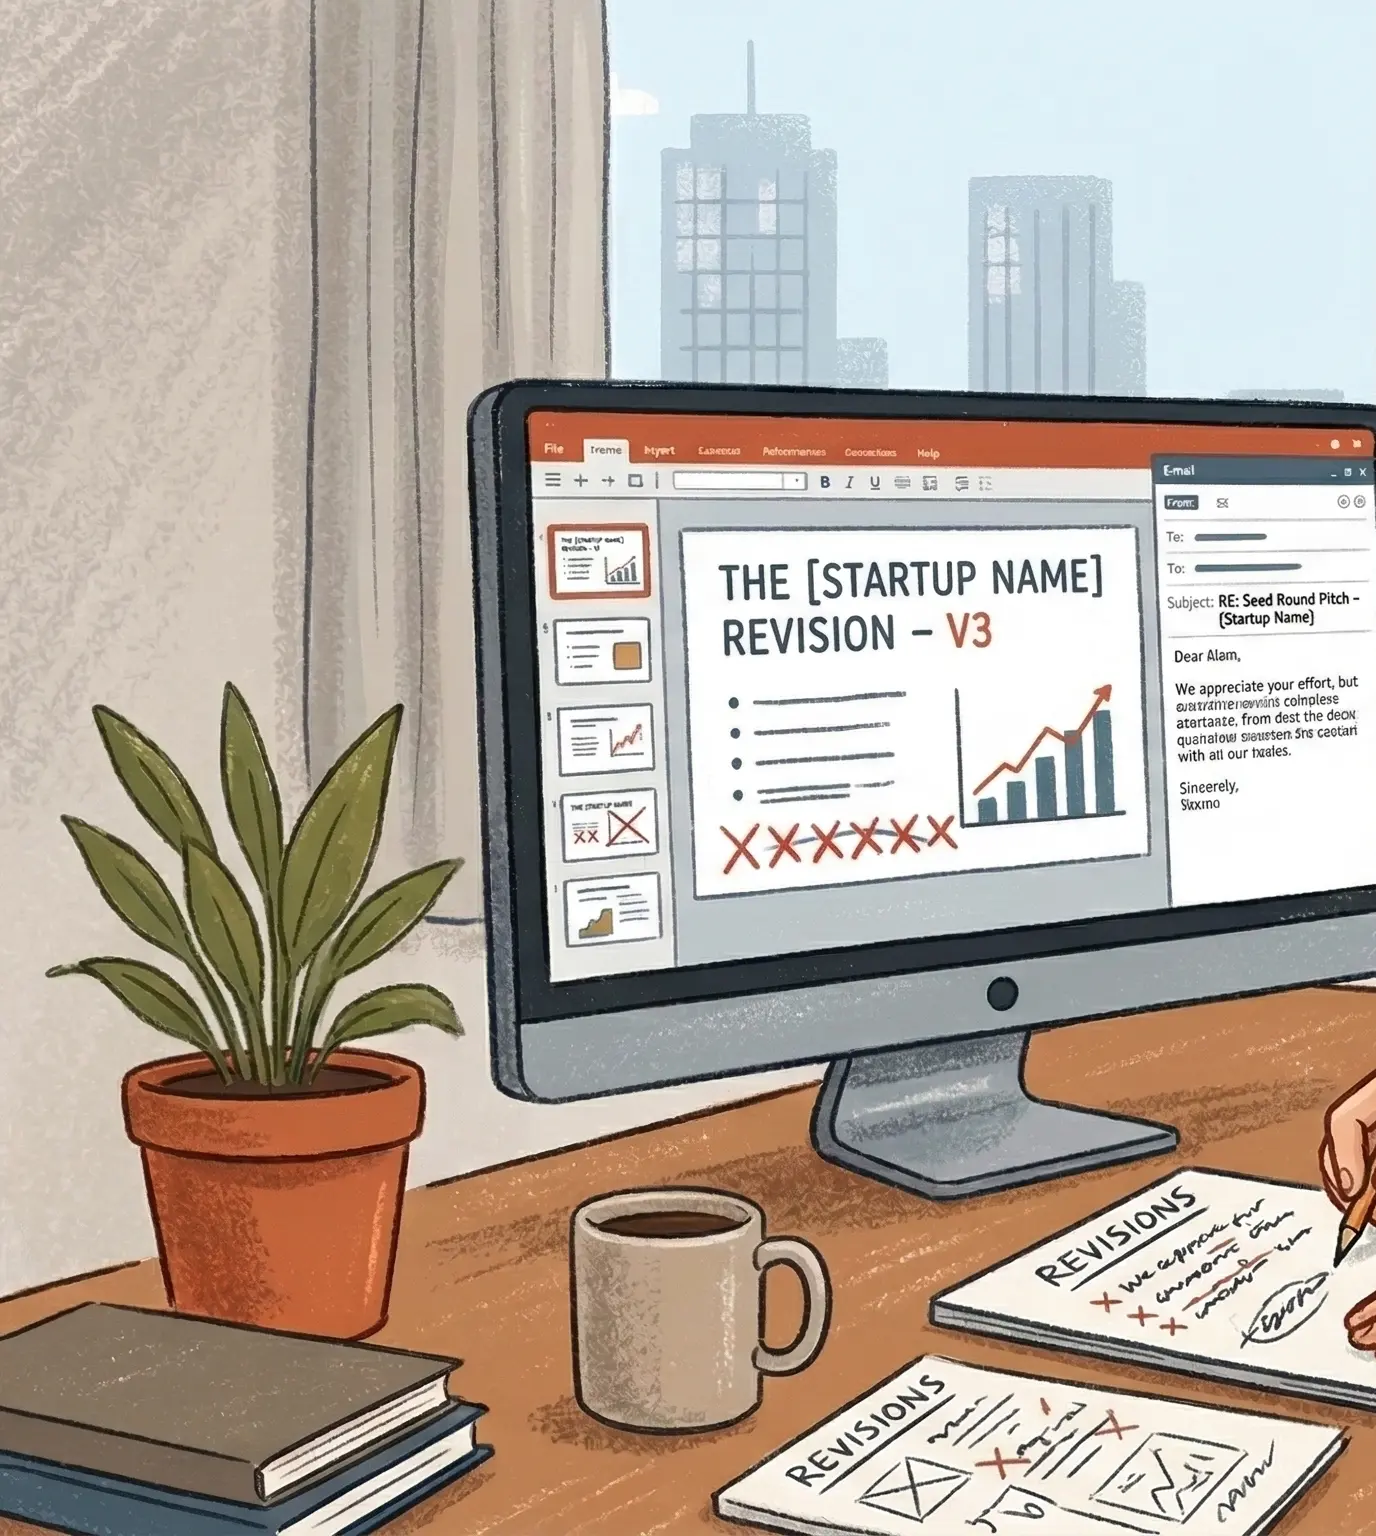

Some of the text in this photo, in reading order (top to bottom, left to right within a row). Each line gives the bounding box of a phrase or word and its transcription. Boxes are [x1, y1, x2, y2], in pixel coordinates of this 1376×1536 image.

[545, 443, 564, 454] File
[1164, 465, 1194, 476] E-mail
[821, 476, 880, 490] B I U
[1167, 563, 1185, 574] To:
[718, 554, 1102, 606] THE [STARTUP NAME]
[1168, 596, 1214, 611] Subject:
[1219, 594, 1239, 607] RE:
[1243, 593, 1273, 607] Seed
[1277, 592, 1315, 606] Round
[1319, 592, 1349, 605] Pitch
[724, 614, 894, 656] REVISION
[946, 612, 992, 648] V3
[1175, 650, 1203, 663] Dear
[1175, 676, 1358, 698] We appreciate your effort, but
[1242, 713, 1271, 725] from
[1275, 712, 1300, 723] dest
[1304, 710, 1323, 722] the
[1178, 749, 1205, 762] with
[1228, 750, 1248, 759] our
[1035, 1185, 1196, 1287] REVISIONS
[785, 1375, 945, 1487] REVISIONS
